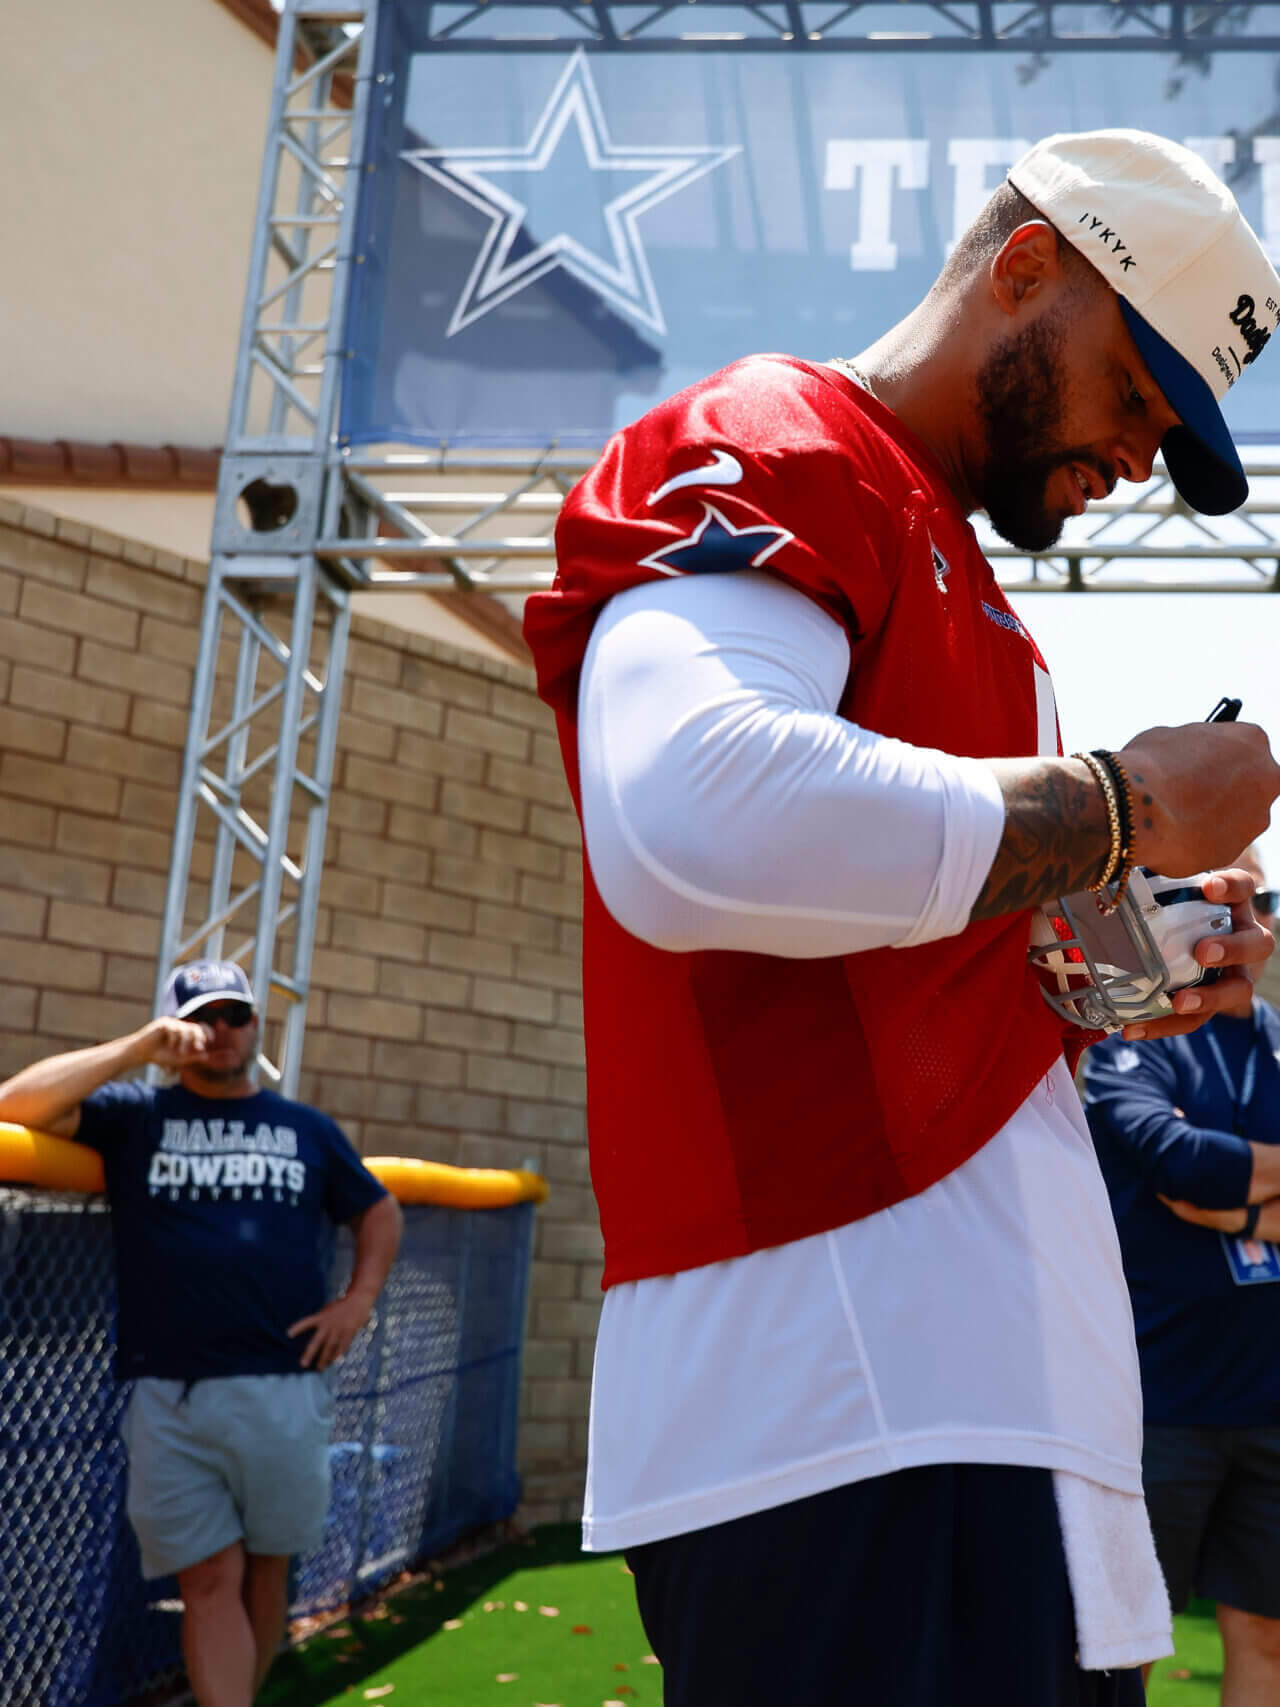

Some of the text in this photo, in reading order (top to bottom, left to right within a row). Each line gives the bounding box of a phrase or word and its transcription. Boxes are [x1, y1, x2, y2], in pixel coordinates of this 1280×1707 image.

[1079, 212, 1137, 273] IYKYK
[160, 1117, 299, 1157] DALLAS
[149, 1152, 305, 1192] COWBOYS
